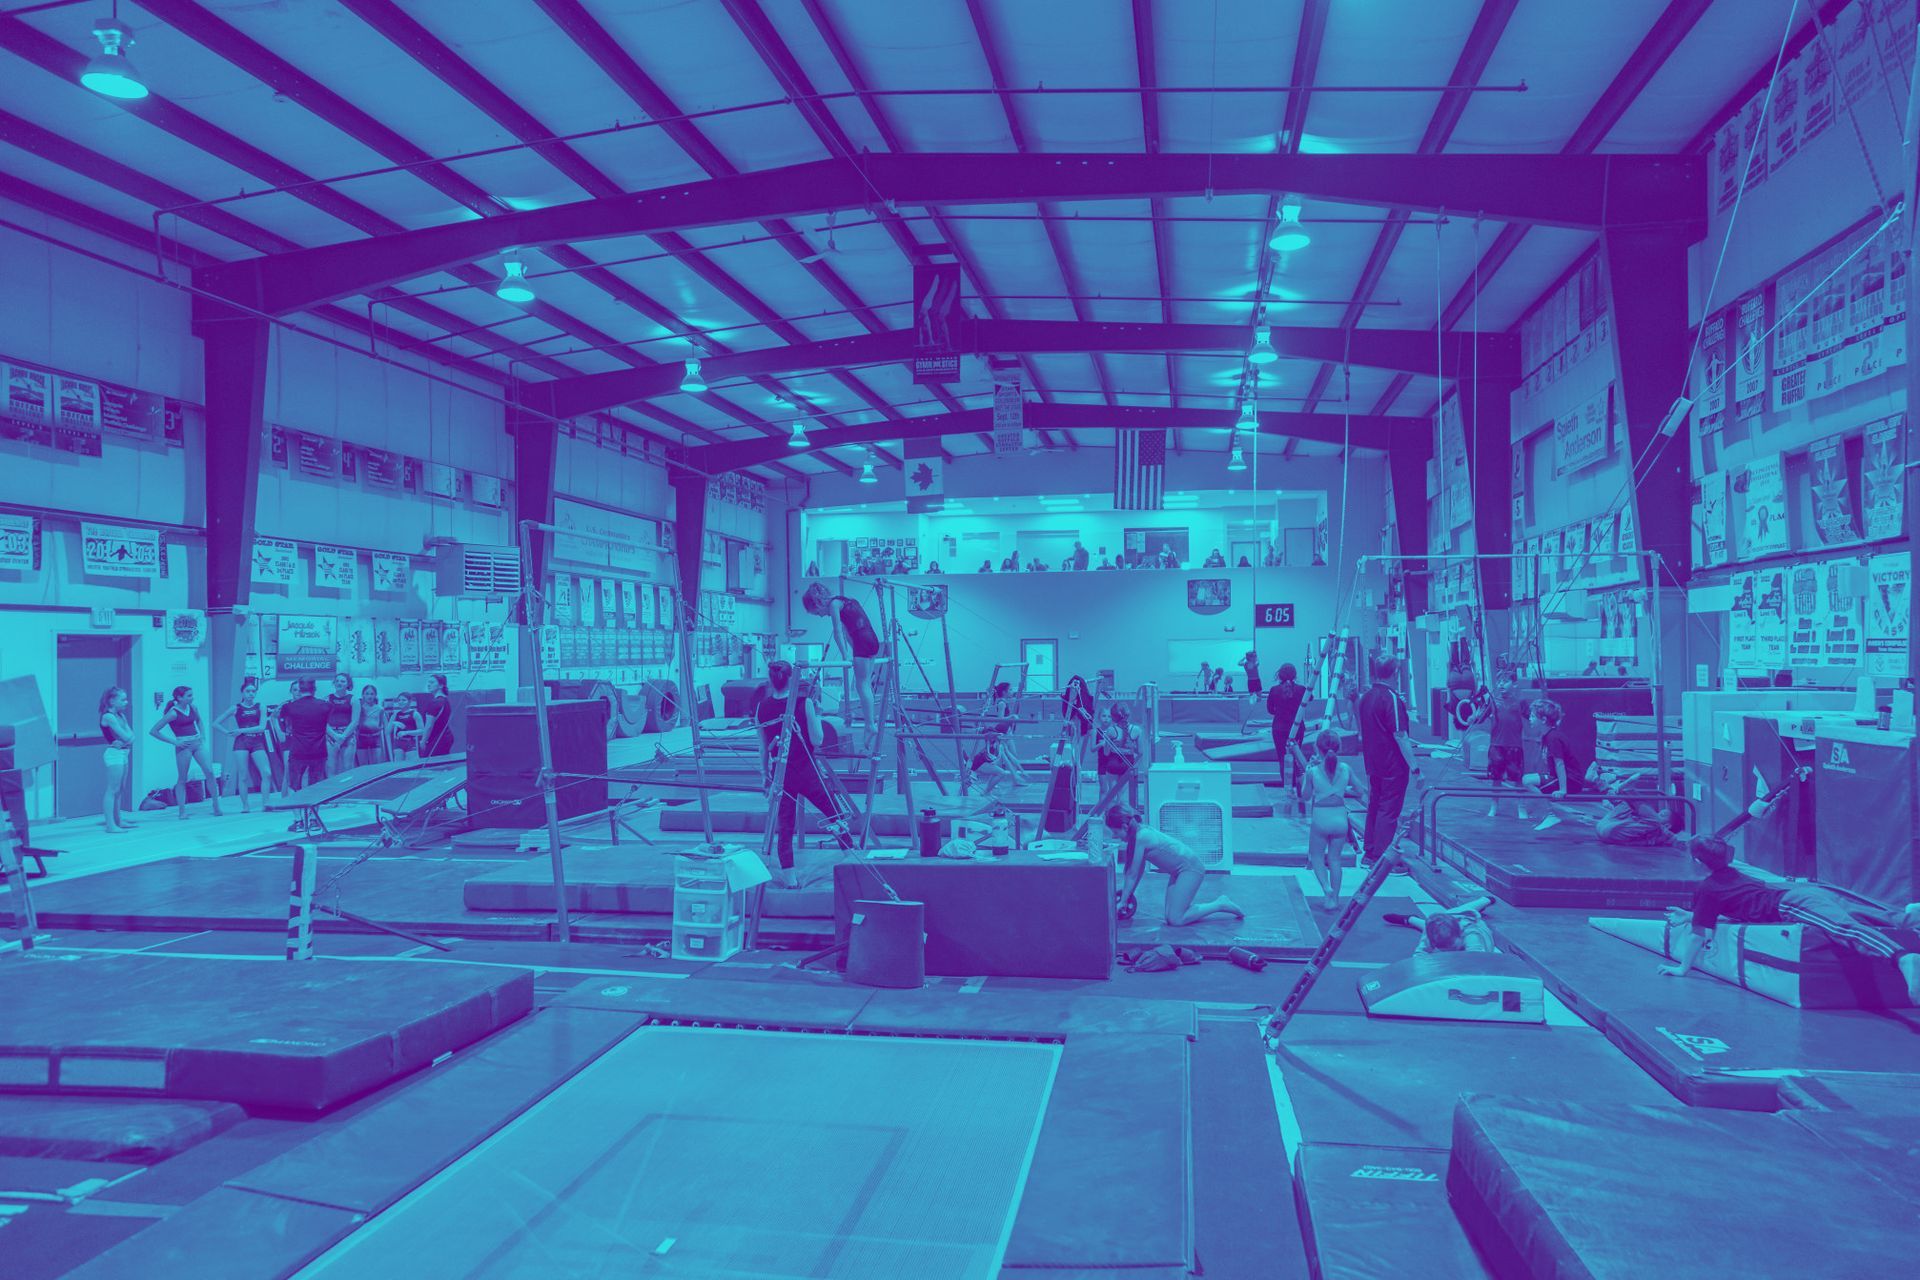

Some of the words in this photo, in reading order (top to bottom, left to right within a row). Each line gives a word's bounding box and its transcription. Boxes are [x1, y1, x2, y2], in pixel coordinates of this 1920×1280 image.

[1564, 427, 1602, 460] Anderson
[1873, 570, 1910, 583] VICTORY
[284, 662, 331, 671] CHALLENGE
[1349, 1168, 1440, 1182] TIFFIN
